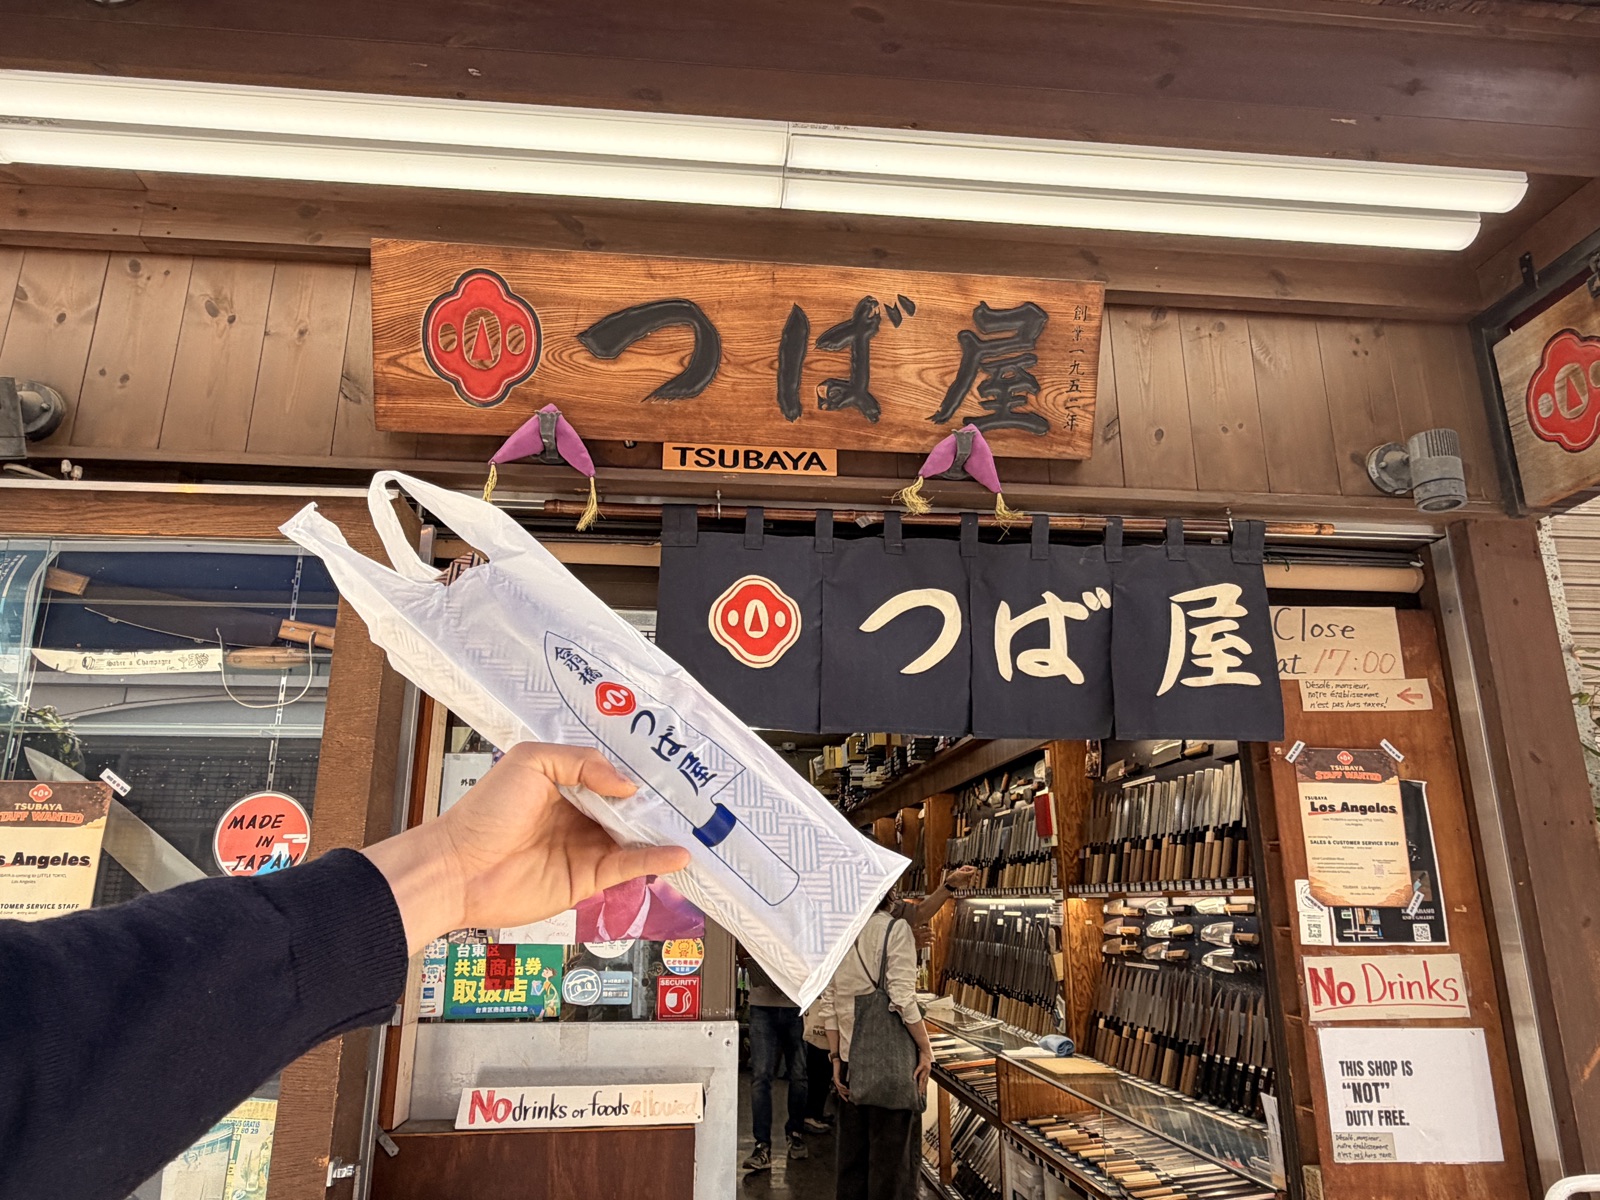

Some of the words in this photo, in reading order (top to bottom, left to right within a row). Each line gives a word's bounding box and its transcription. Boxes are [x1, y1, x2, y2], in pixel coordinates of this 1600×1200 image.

[576, 294, 1050, 437] つば屋
[672, 446, 828, 472] TSUBAYA
[1273, 607, 1356, 642] Close
[858, 582, 1263, 698] つば屋
[1277, 653, 1307, 675] at
[1313, 649, 1396, 676] 17:00
[629, 709, 718, 797] つば屋
[14, 803, 63, 811] TSUBAYA
[1310, 801, 1336, 813] Los
[1340, 802, 1397, 816] Angeles
[0, 811, 30, 823] TAFF
[31, 811, 85, 825] WANTED
[227, 814, 286, 831] MADE
[255, 835, 275, 848] IN
[231, 853, 300, 872] JAPAN
[456, 944, 501, 958] 台東区
[453, 957, 542, 978] 共通商品券
[1307, 966, 1357, 1007] No
[1360, 959, 1460, 1004] Drinks
[1338, 1060, 1365, 1077] THIS
[1367, 1060, 1398, 1077] SHOP
[1401, 1060, 1414, 1077] IS
[467, 1089, 513, 1125] No
[512, 1092, 567, 1122] drinks
[571, 1108, 588, 1119] or
[588, 1090, 630, 1117] foods
[1344, 1109, 1374, 1127] DUTY
[1377, 1109, 1410, 1127] FREE.
